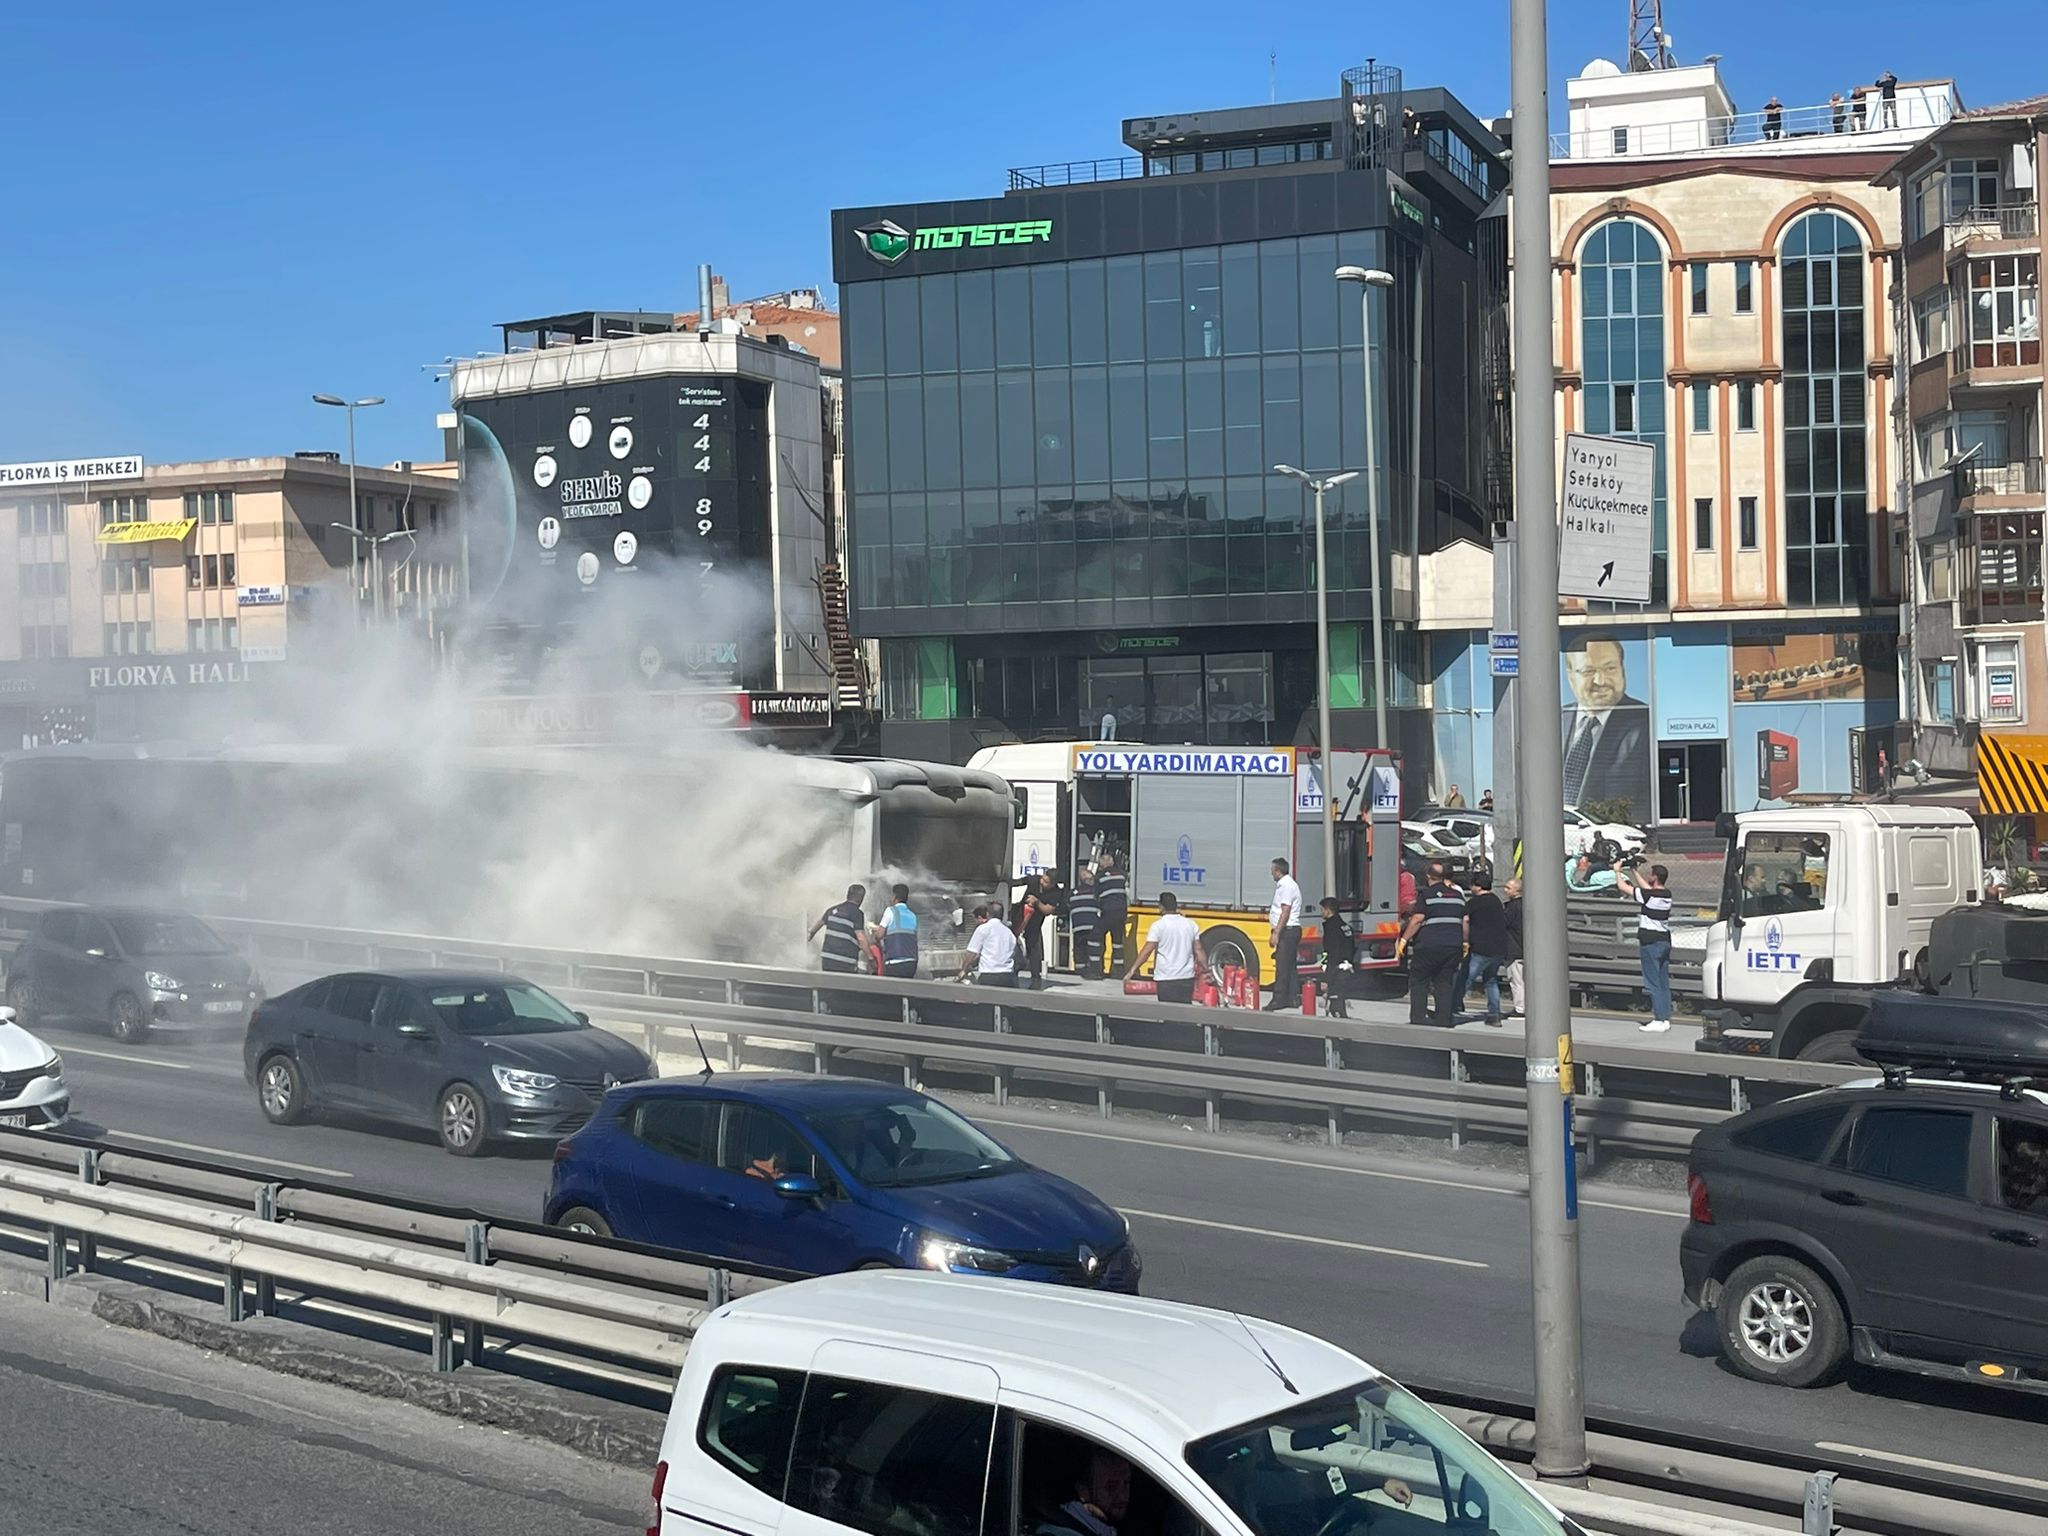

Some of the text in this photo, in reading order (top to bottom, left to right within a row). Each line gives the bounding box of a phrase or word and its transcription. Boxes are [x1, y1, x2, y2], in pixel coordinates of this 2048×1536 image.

[914, 220, 1052, 250] MONSTER
[1571, 447, 1617, 469] Yanyol
[0, 457, 137, 482] FLORYA İŞ MERKEZİ
[561, 470, 622, 502] SERVİS
[1569, 470, 1623, 494] Sefaköy
[1567, 492, 1648, 515] Küçükçekmece
[1566, 515, 1615, 534] Halkalı
[1120, 636, 1180, 648] MONSTER
[90, 666, 177, 687] FLORYA
[1694, 722, 1715, 730] PLAZA
[1163, 863, 1206, 882] İETT
[1747, 948, 1801, 969] İETT
